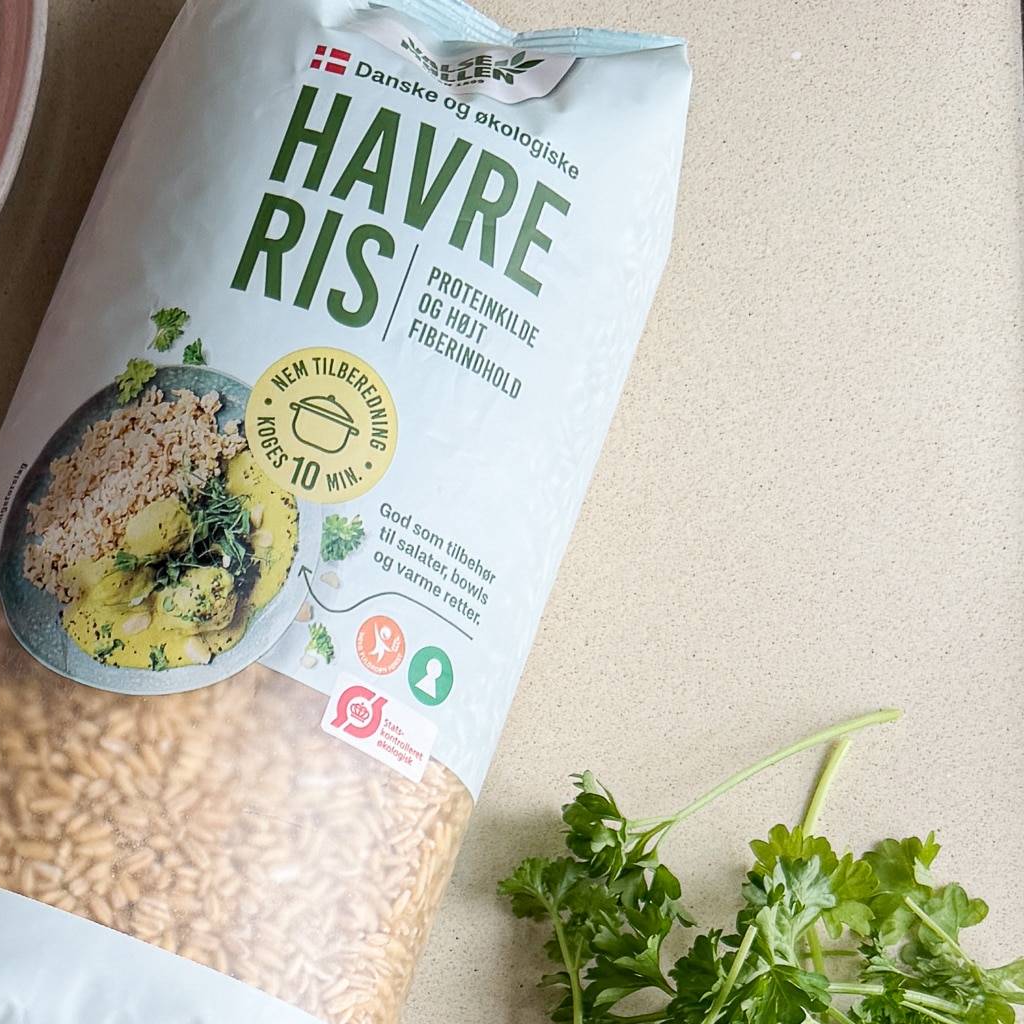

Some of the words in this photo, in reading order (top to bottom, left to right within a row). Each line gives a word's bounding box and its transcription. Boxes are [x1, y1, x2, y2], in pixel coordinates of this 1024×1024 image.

[354, 61, 439, 103] Danske
[443, 96, 471, 120] og
[475, 111, 580, 180] økologiske
[269, 84, 572, 298] HAVRE
[230, 192, 396, 328] RIS
[418, 293, 443, 319] OG
[445, 306, 488, 344] HØJT
[427, 266, 540, 348] PROTEINKILDE
[408, 318, 522, 399] FIBERINDHOLD
[271, 359, 309, 392] NEM
[312, 357, 389, 451] TILBEREDNING
[257, 416, 289, 469] KOGES
[290, 456, 321, 491] 10
[326, 467, 363, 492] MIN.
[379, 526, 396, 545] til
[396, 539, 448, 580] salater,
[450, 568, 489, 605] bowls
[380, 502, 412, 529] God
[412, 523, 444, 549] som
[446, 541, 496, 584] tilbehør
[373, 551, 394, 571] og
[397, 562, 442, 597] varme
[443, 591, 480, 625] retter.
[377, 739, 413, 766] økologisk
[380, 728, 424, 761] kontrolleret
[383, 718, 404, 736] Stats-
